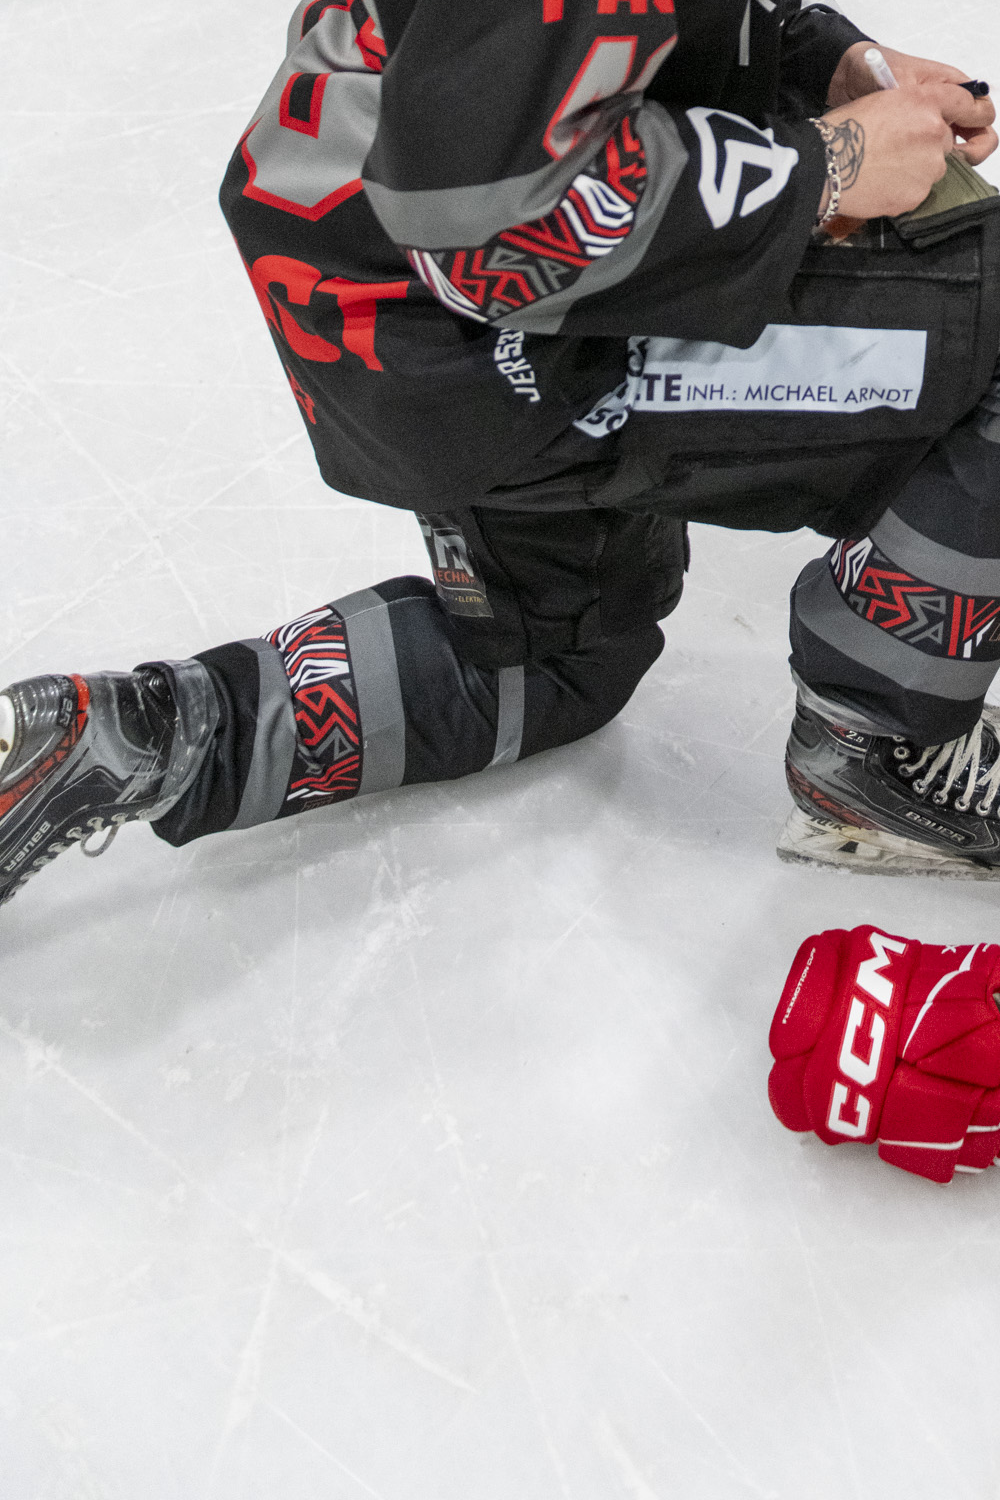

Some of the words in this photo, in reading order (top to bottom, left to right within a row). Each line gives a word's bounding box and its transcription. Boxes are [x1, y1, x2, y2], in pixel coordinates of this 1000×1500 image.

[634, 373, 683, 402] TE
[686, 384, 736, 402] INH.:
[744, 384, 838, 402] MICHAEL
[844, 387, 913, 404] ARNDT
[433, 568, 478, 585] ECHN
[828, 931, 907, 1138] CCM
